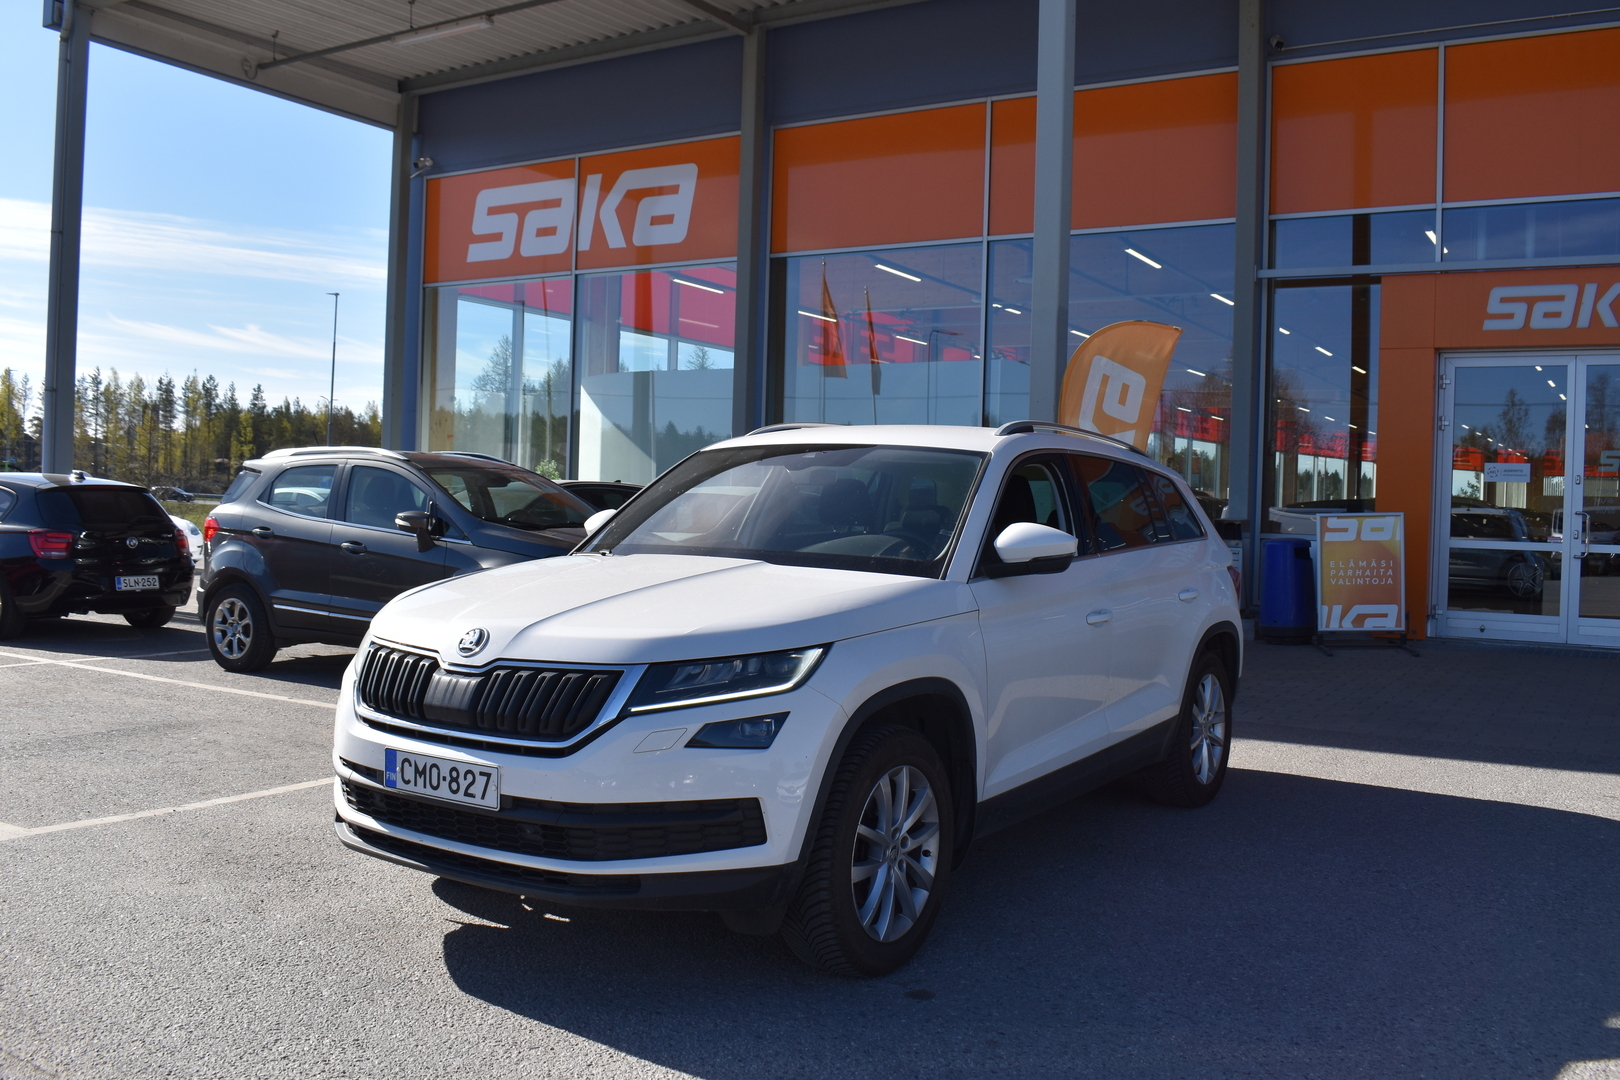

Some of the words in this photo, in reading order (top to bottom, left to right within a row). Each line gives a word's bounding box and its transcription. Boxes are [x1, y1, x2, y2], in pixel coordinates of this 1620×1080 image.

[1330, 559, 1393, 567] ELÄMÄSI
[1330, 568, 1393, 576] PARHAITA
[123, 577, 157, 588] SLN-252
[1330, 577, 1393, 585] VALINTOJA
[386, 772, 396, 782] FIN
[401, 757, 492, 800] CMO-827
